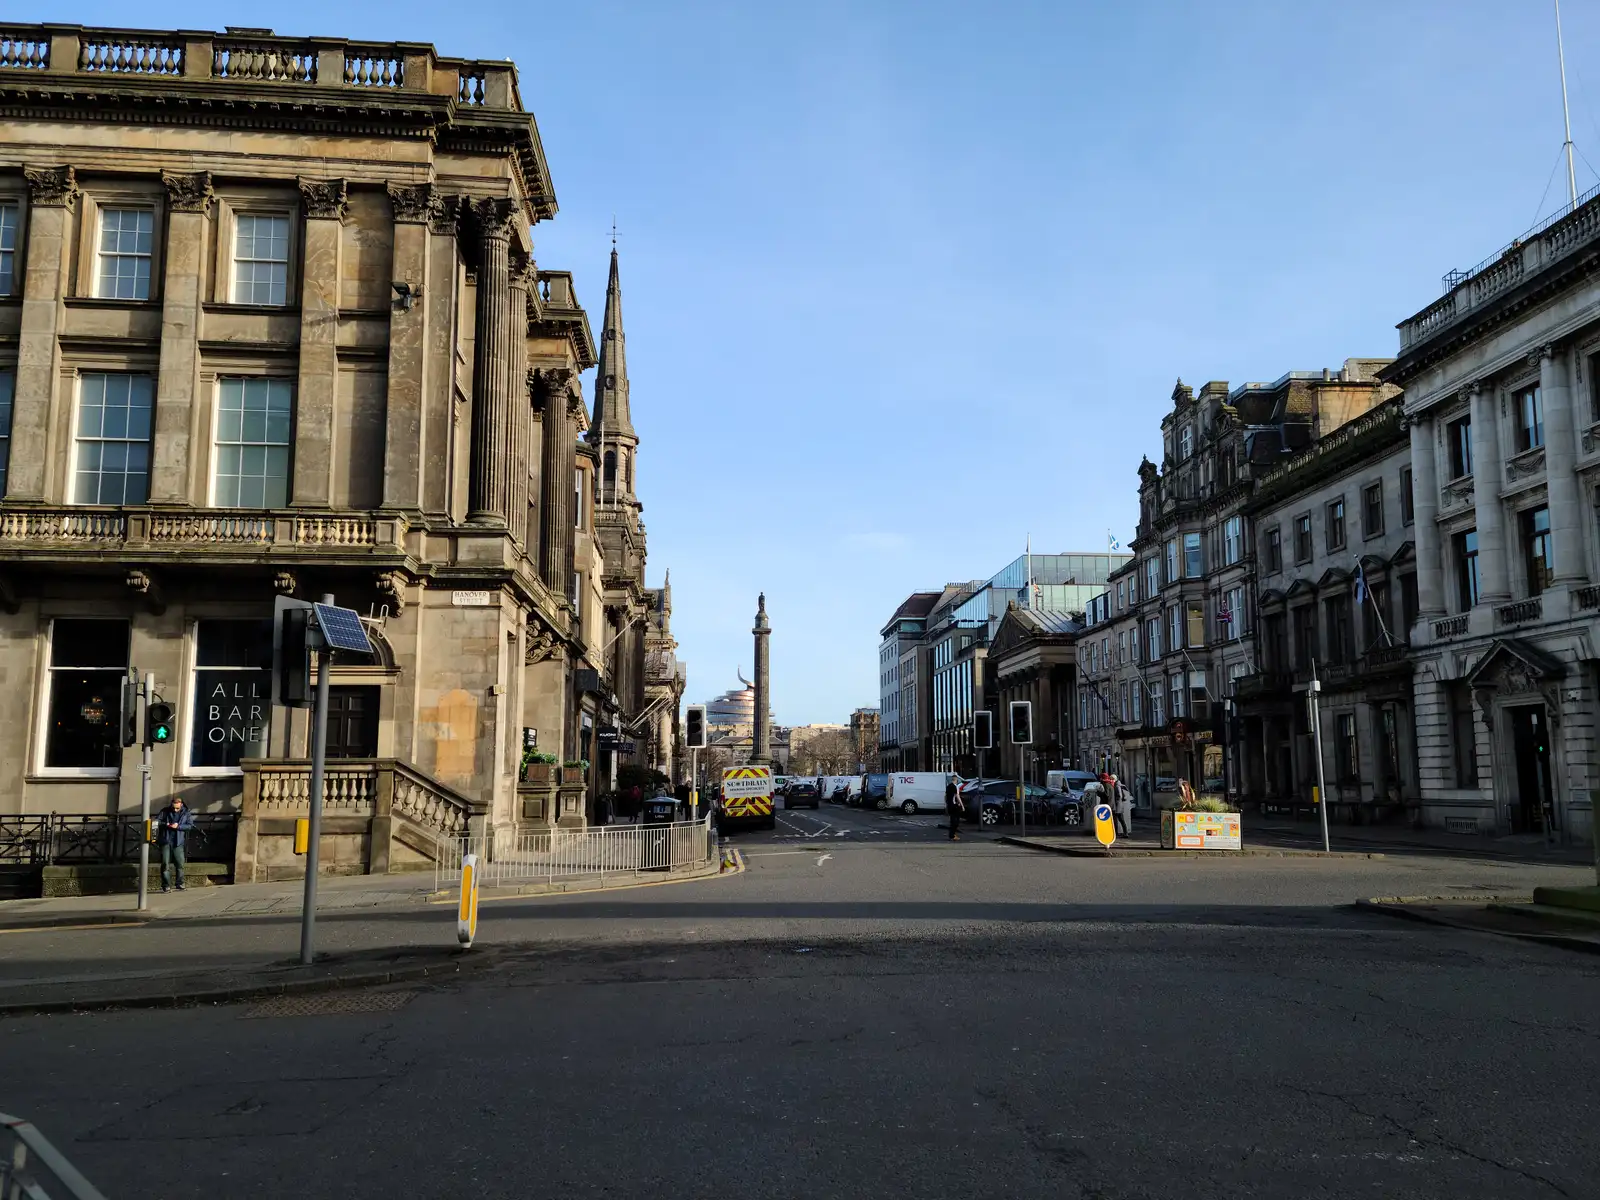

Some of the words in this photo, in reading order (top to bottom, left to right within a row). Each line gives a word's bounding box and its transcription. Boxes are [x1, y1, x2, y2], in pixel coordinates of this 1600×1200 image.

[212, 682, 261, 698] ALL
[209, 704, 262, 721] BAR
[208, 726, 260, 743] ONE
[898, 776, 914, 784] TKE
